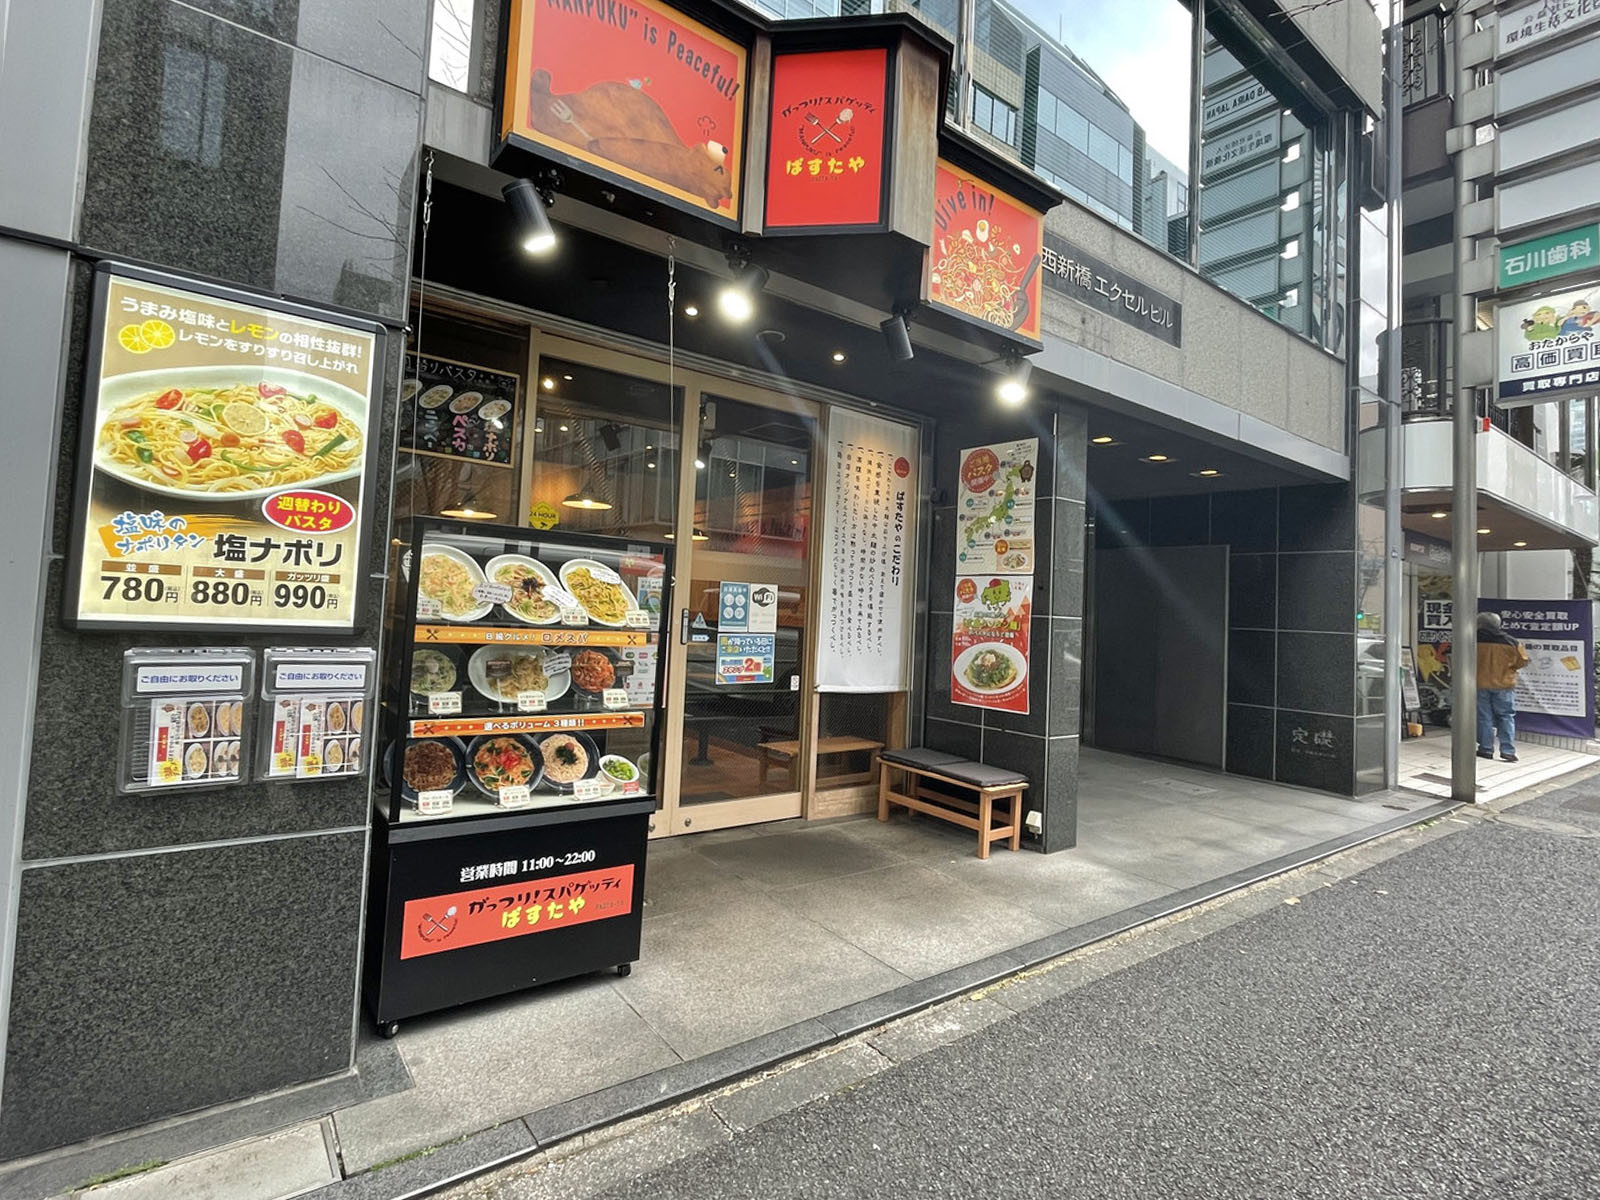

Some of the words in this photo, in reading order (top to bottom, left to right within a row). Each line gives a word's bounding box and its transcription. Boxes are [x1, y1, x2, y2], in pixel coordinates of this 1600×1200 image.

[644, 17, 658, 45] is
[667, 30, 741, 101] Peaceful!
[971, 185, 995, 216] in!
[1505, 238, 1592, 276] 石川歯科
[1042, 246, 1173, 329] 西新橋エクセルビル
[179, 329, 359, 375] レモンをすりすり召し上がれ
[1529, 332, 1594, 351] おたからや
[1522, 371, 1600, 392] 買取専門店
[277, 495, 341, 514] 週替わり
[112, 510, 187, 535] 塩味の
[284, 514, 333, 531] パスタ
[116, 534, 205, 554] ナポリタン
[213, 533, 343, 567] 塩ナポリ
[1499, 621, 1580, 631] とめて査定額UP
[140, 674, 239, 684] ご自由にお取りください
[279, 671, 362, 681] ご自由にお取りください
[459, 860, 518, 883] 営業時間
